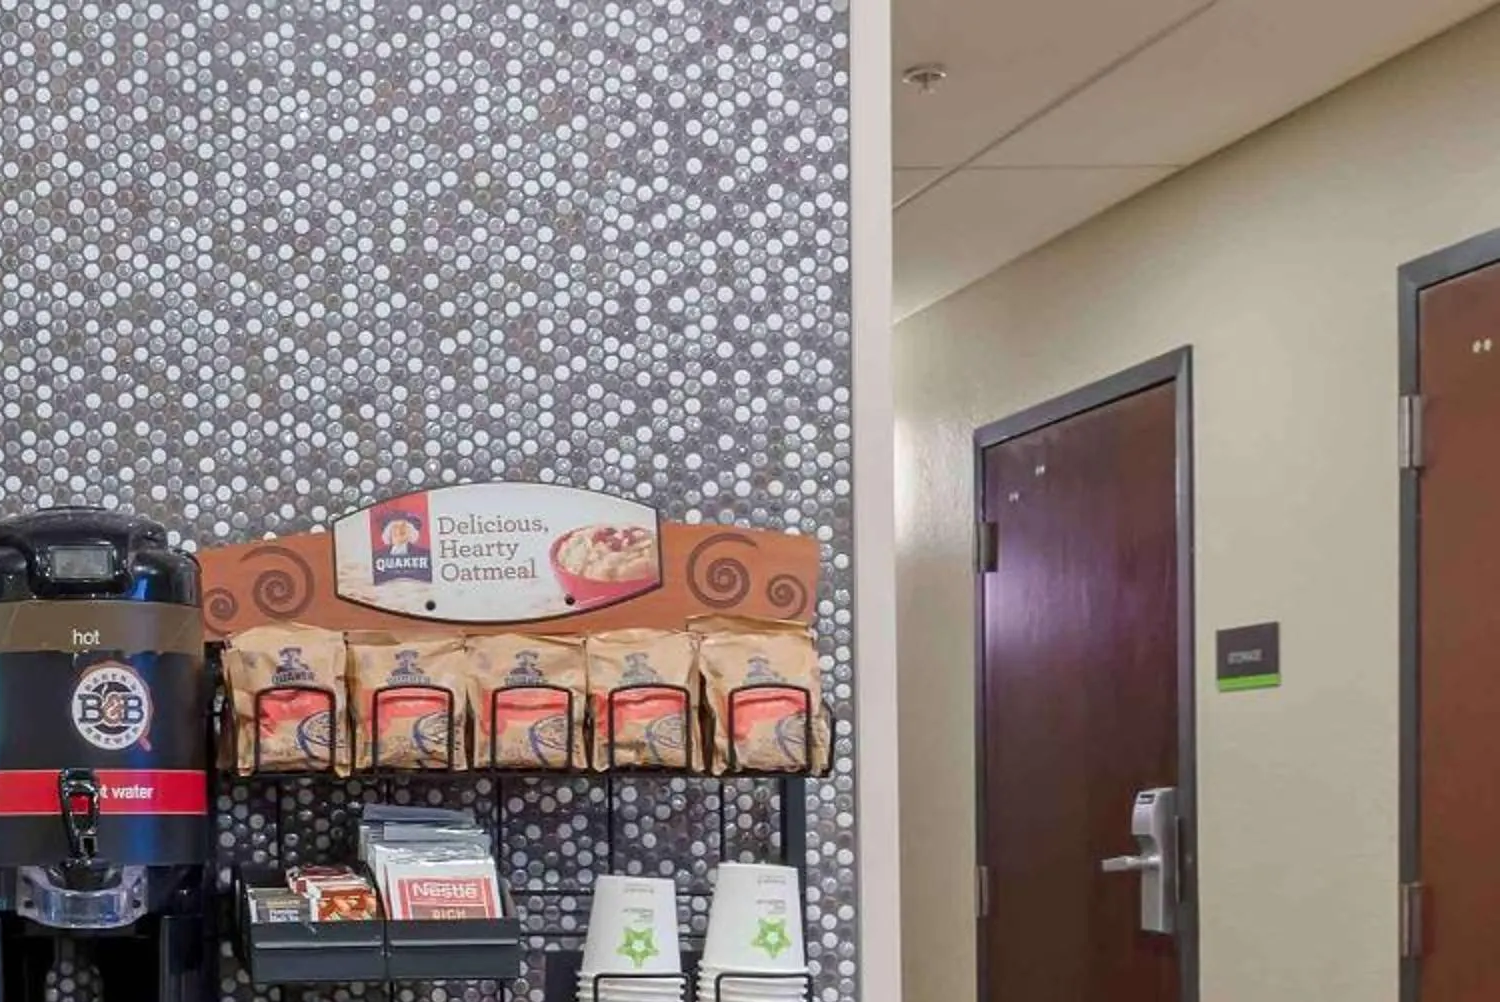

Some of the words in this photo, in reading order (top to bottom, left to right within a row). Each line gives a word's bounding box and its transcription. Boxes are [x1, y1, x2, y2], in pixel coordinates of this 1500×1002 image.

[438, 514, 549, 535] Delicious,
[439, 539, 520, 560] Hearty
[376, 556, 429, 573] QUAKER
[441, 558, 537, 582] Oatmeal
[72, 628, 101, 646] hot
[78, 692, 145, 725] B&B
[111, 783, 155, 799] water
